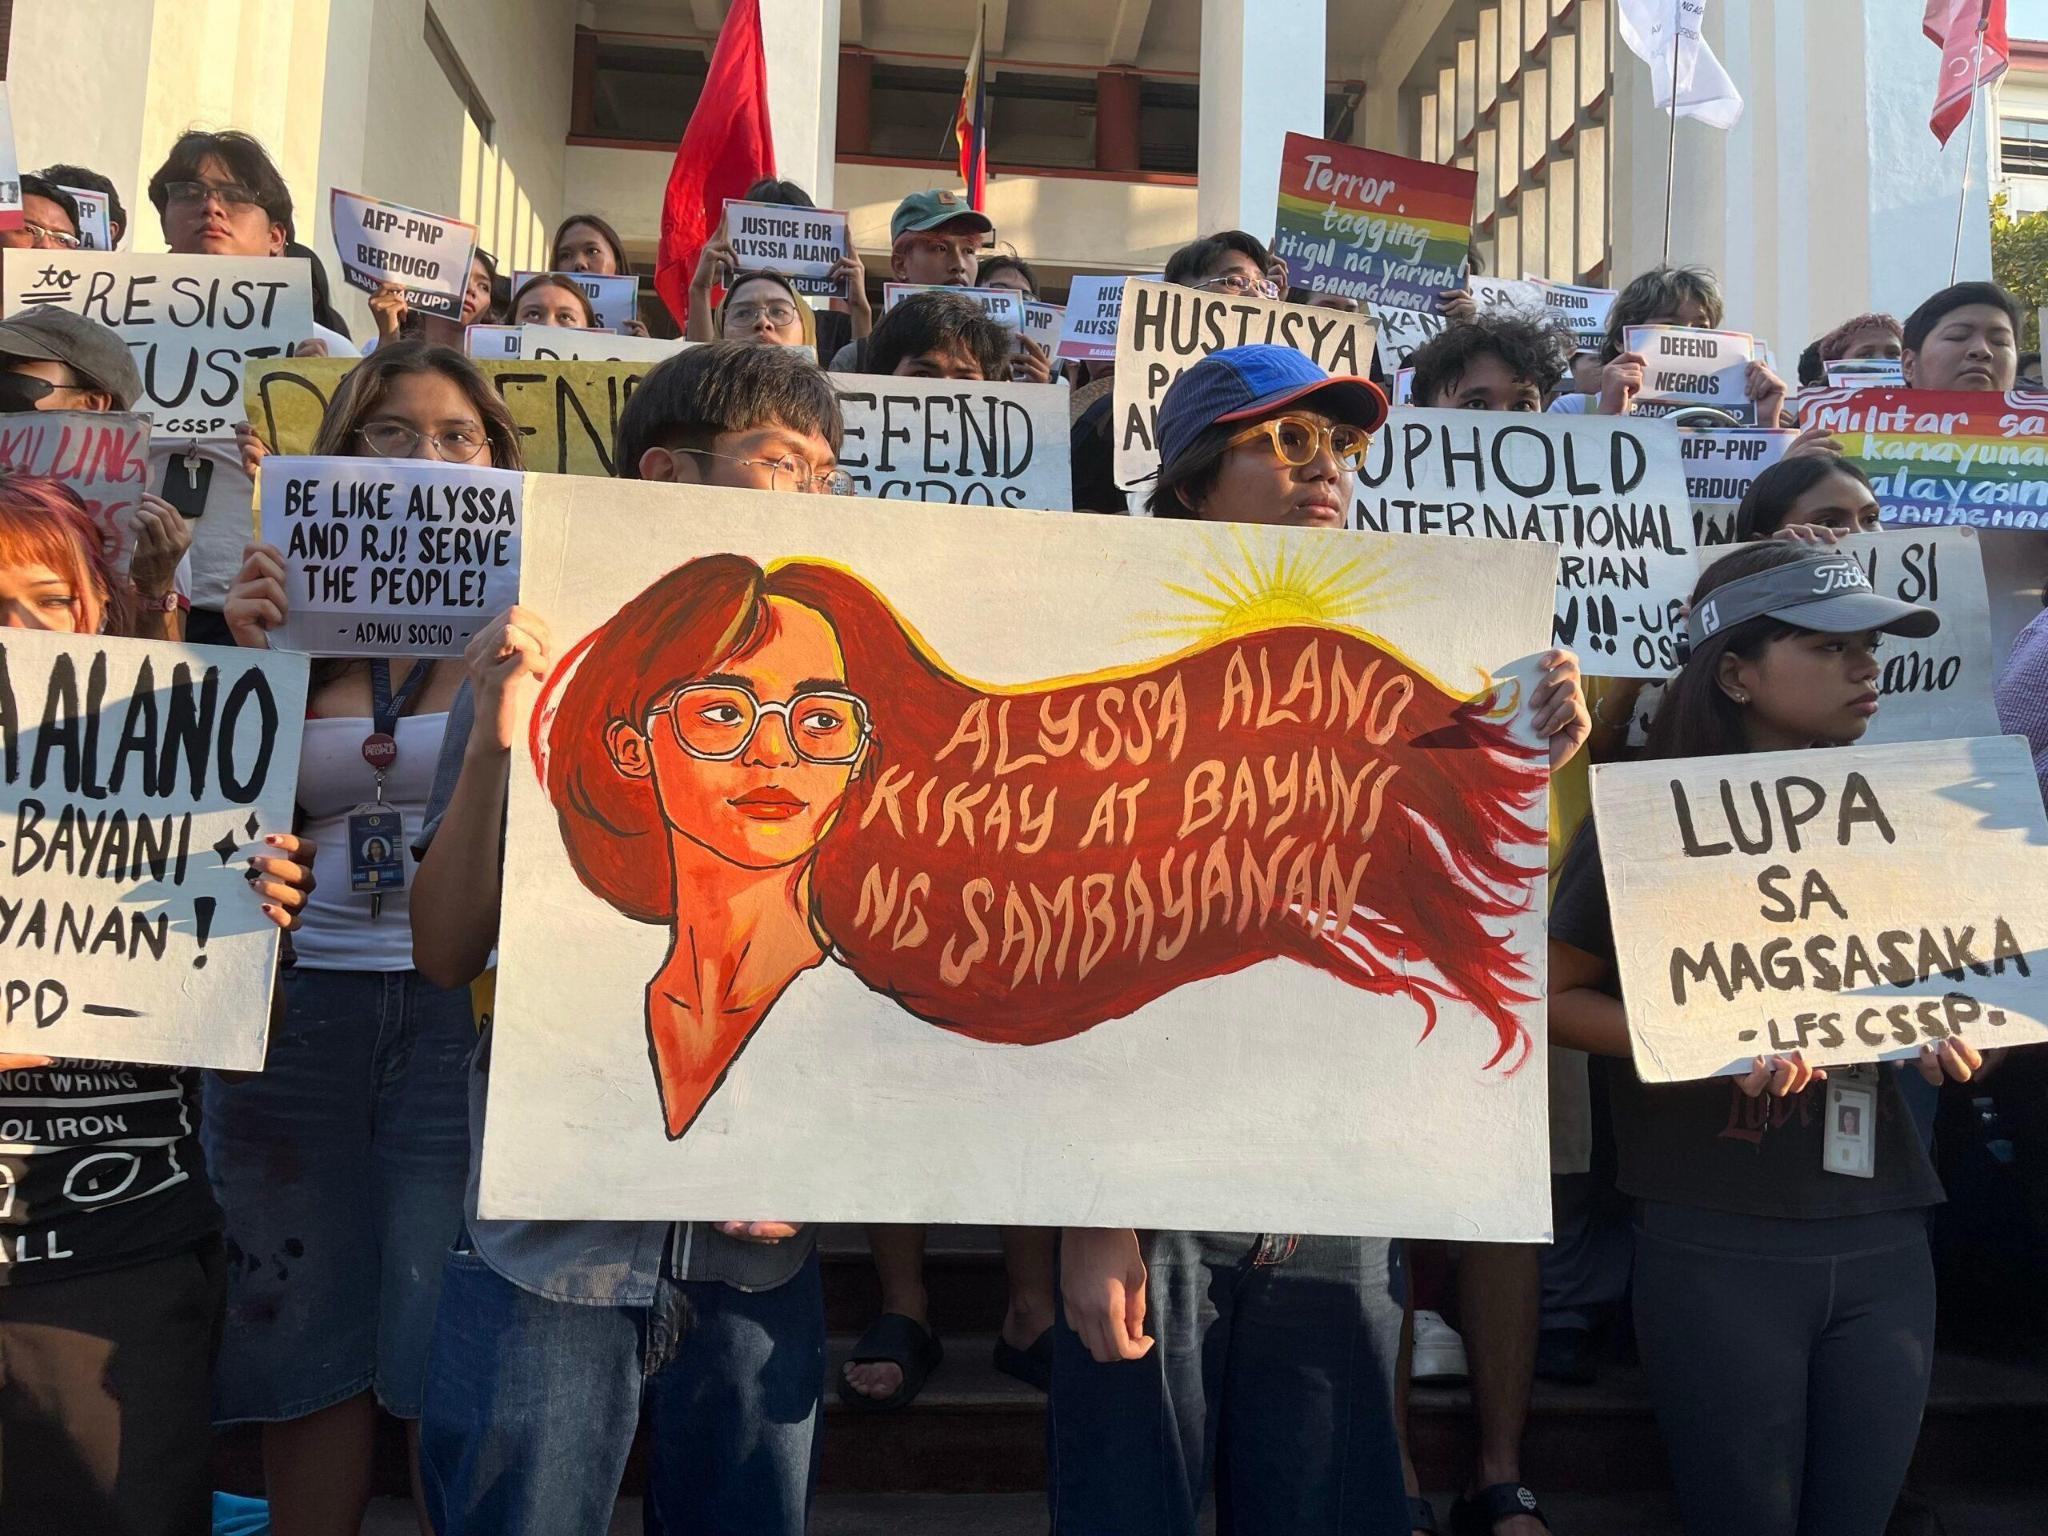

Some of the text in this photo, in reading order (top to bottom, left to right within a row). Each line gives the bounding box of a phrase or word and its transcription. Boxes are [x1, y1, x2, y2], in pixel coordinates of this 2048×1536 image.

[1304, 155, 1395, 206] Terror
[79, 201, 96, 218] FP
[362, 207, 443, 245] AFP-PNP
[741, 216, 832, 241] JUSTICE FOR
[732, 239, 840, 264] ALYSSA ALANO
[1322, 200, 1431, 265] tagging
[357, 243, 440, 281] BERDUGO
[1344, 252, 1373, 275] na
[32, 264, 289, 330] to RESIST
[421, 294, 451, 310] UPD
[811, 278, 837, 293] UPD
[1545, 291, 1588, 308] DEFEND
[1073, 319, 1118, 335] ALYSS
[1660, 336, 1718, 358] DEFEND
[1655, 371, 1720, 394] NEGROS
[835, 393, 1034, 479] EFEND
[1818, 394, 2047, 438] Militar sa
[1356, 423, 1647, 499] UPHOLD
[1680, 438, 1767, 461] AFP-PNP
[1862, 433, 2048, 475] kanayuna
[284, 479, 517, 526] BE LIKE ALYSSA
[1685, 478, 1751, 500] ERDUG
[287, 521, 512, 567] AND RJ! SERVE
[1344, 497, 1689, 556] NTERNATIONAL
[302, 564, 487, 608] THE PEOPLE!
[1897, 542, 1938, 604] SI
[355, 622, 402, 644] ADMU
[408, 623, 453, 645] SOCIO
[1876, 650, 1961, 696] ano
[30, 649, 279, 803] ALANO
[934, 637, 1415, 778] ALYSSA ALANO
[859, 745, 1401, 855] KIKAY AT BAYANI
[1670, 771, 1896, 858] LUPA
[854, 835, 1373, 991] NG SAMBAYANAN
[1757, 864, 1848, 923] SA
[1669, 914, 2031, 1006] MAGSASAKA
[0, 979, 68, 1028] PD
[51, 1071, 138, 1092] WRING
[46, 1114, 128, 1141] IRON
